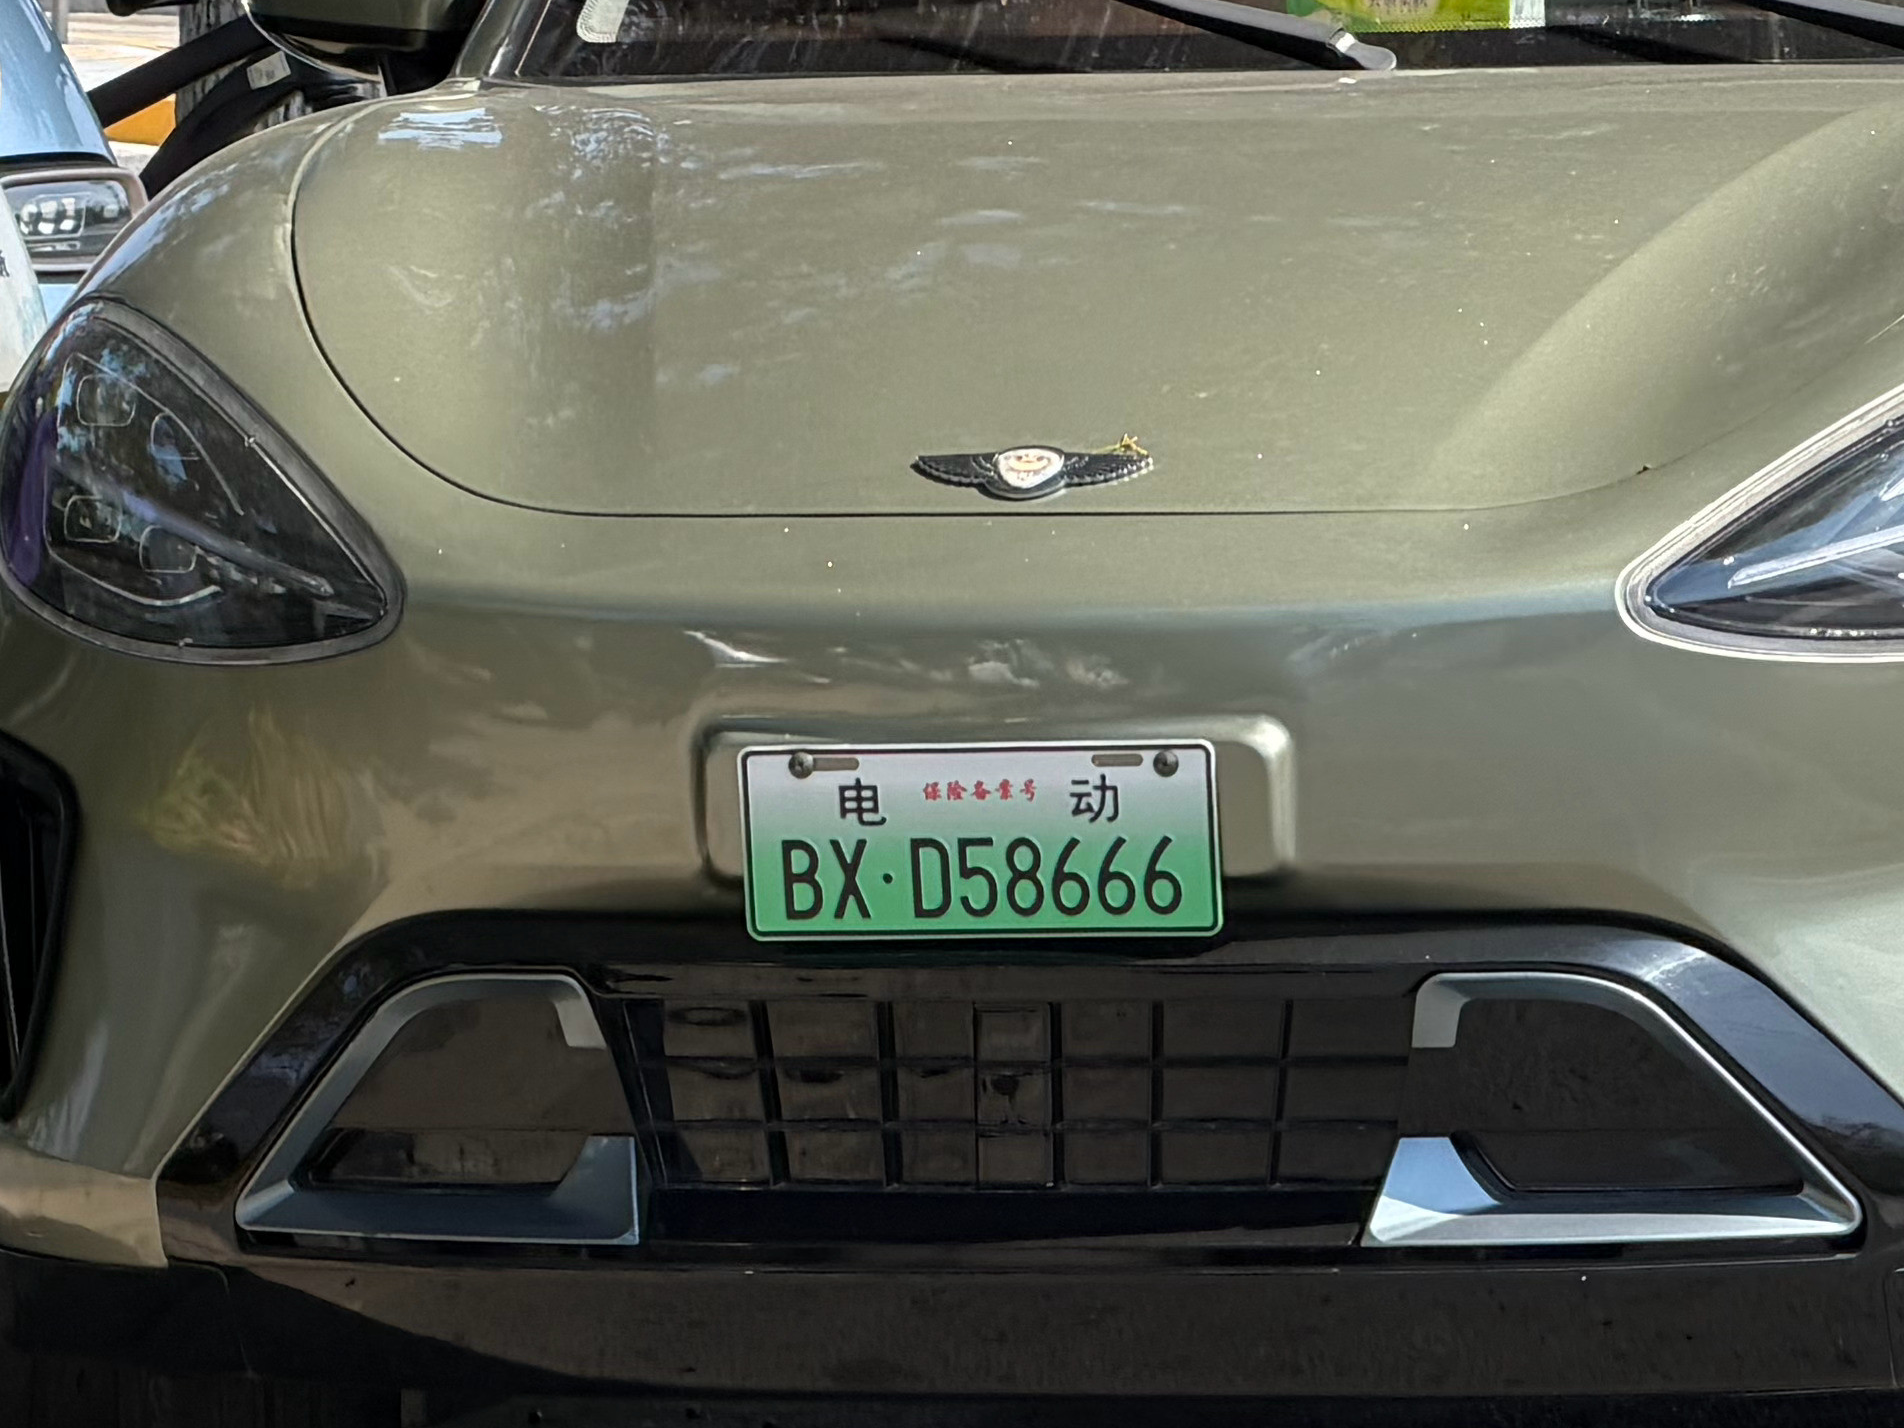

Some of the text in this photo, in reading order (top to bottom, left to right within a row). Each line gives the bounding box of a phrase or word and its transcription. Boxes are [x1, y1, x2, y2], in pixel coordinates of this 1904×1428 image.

[838, 774, 1120, 826] 电 动
[922, 779, 1038, 802] 保险备案号
